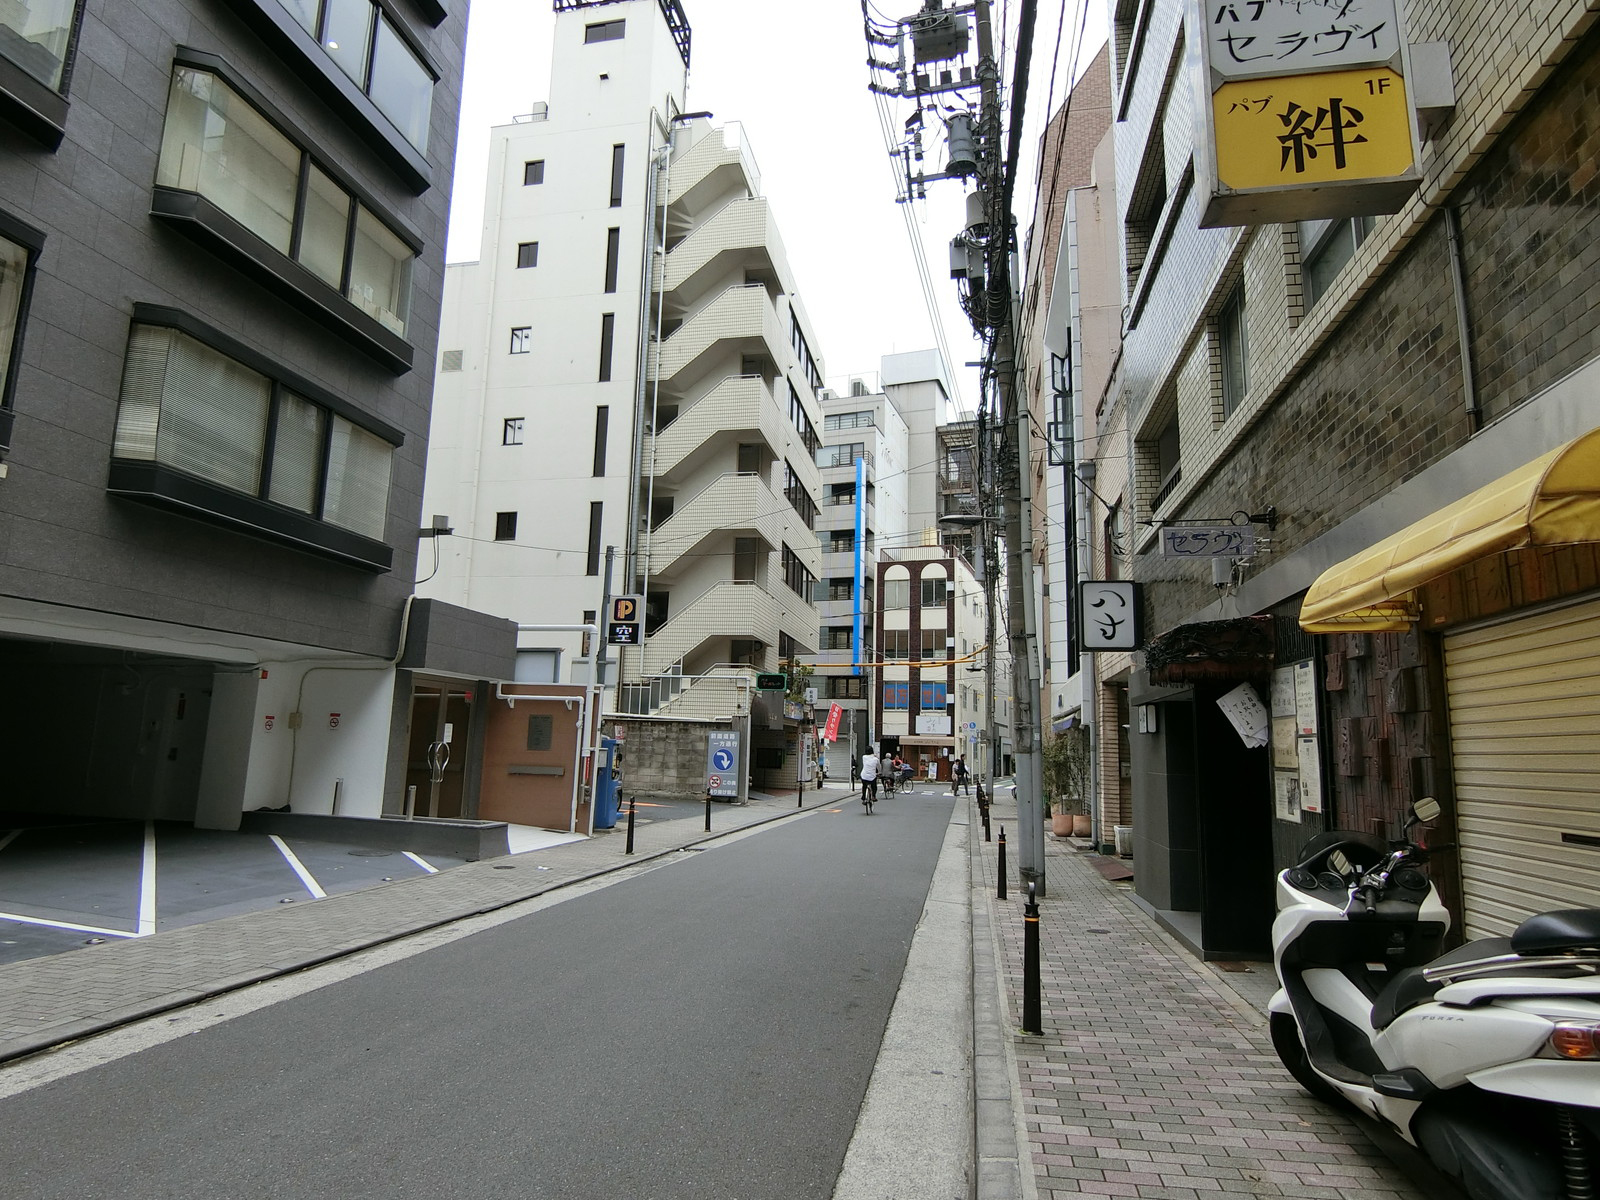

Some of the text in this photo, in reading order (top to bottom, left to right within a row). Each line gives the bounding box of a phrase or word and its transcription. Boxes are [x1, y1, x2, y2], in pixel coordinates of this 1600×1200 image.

[1214, 0, 1271, 24] パブ
[1216, 21, 1387, 62] セラヴィ
[1364, 77, 1391, 96] 1F
[1227, 94, 1275, 115] パブ
[1276, 97, 1369, 173] 絆
[615, 625, 633, 642] 空
